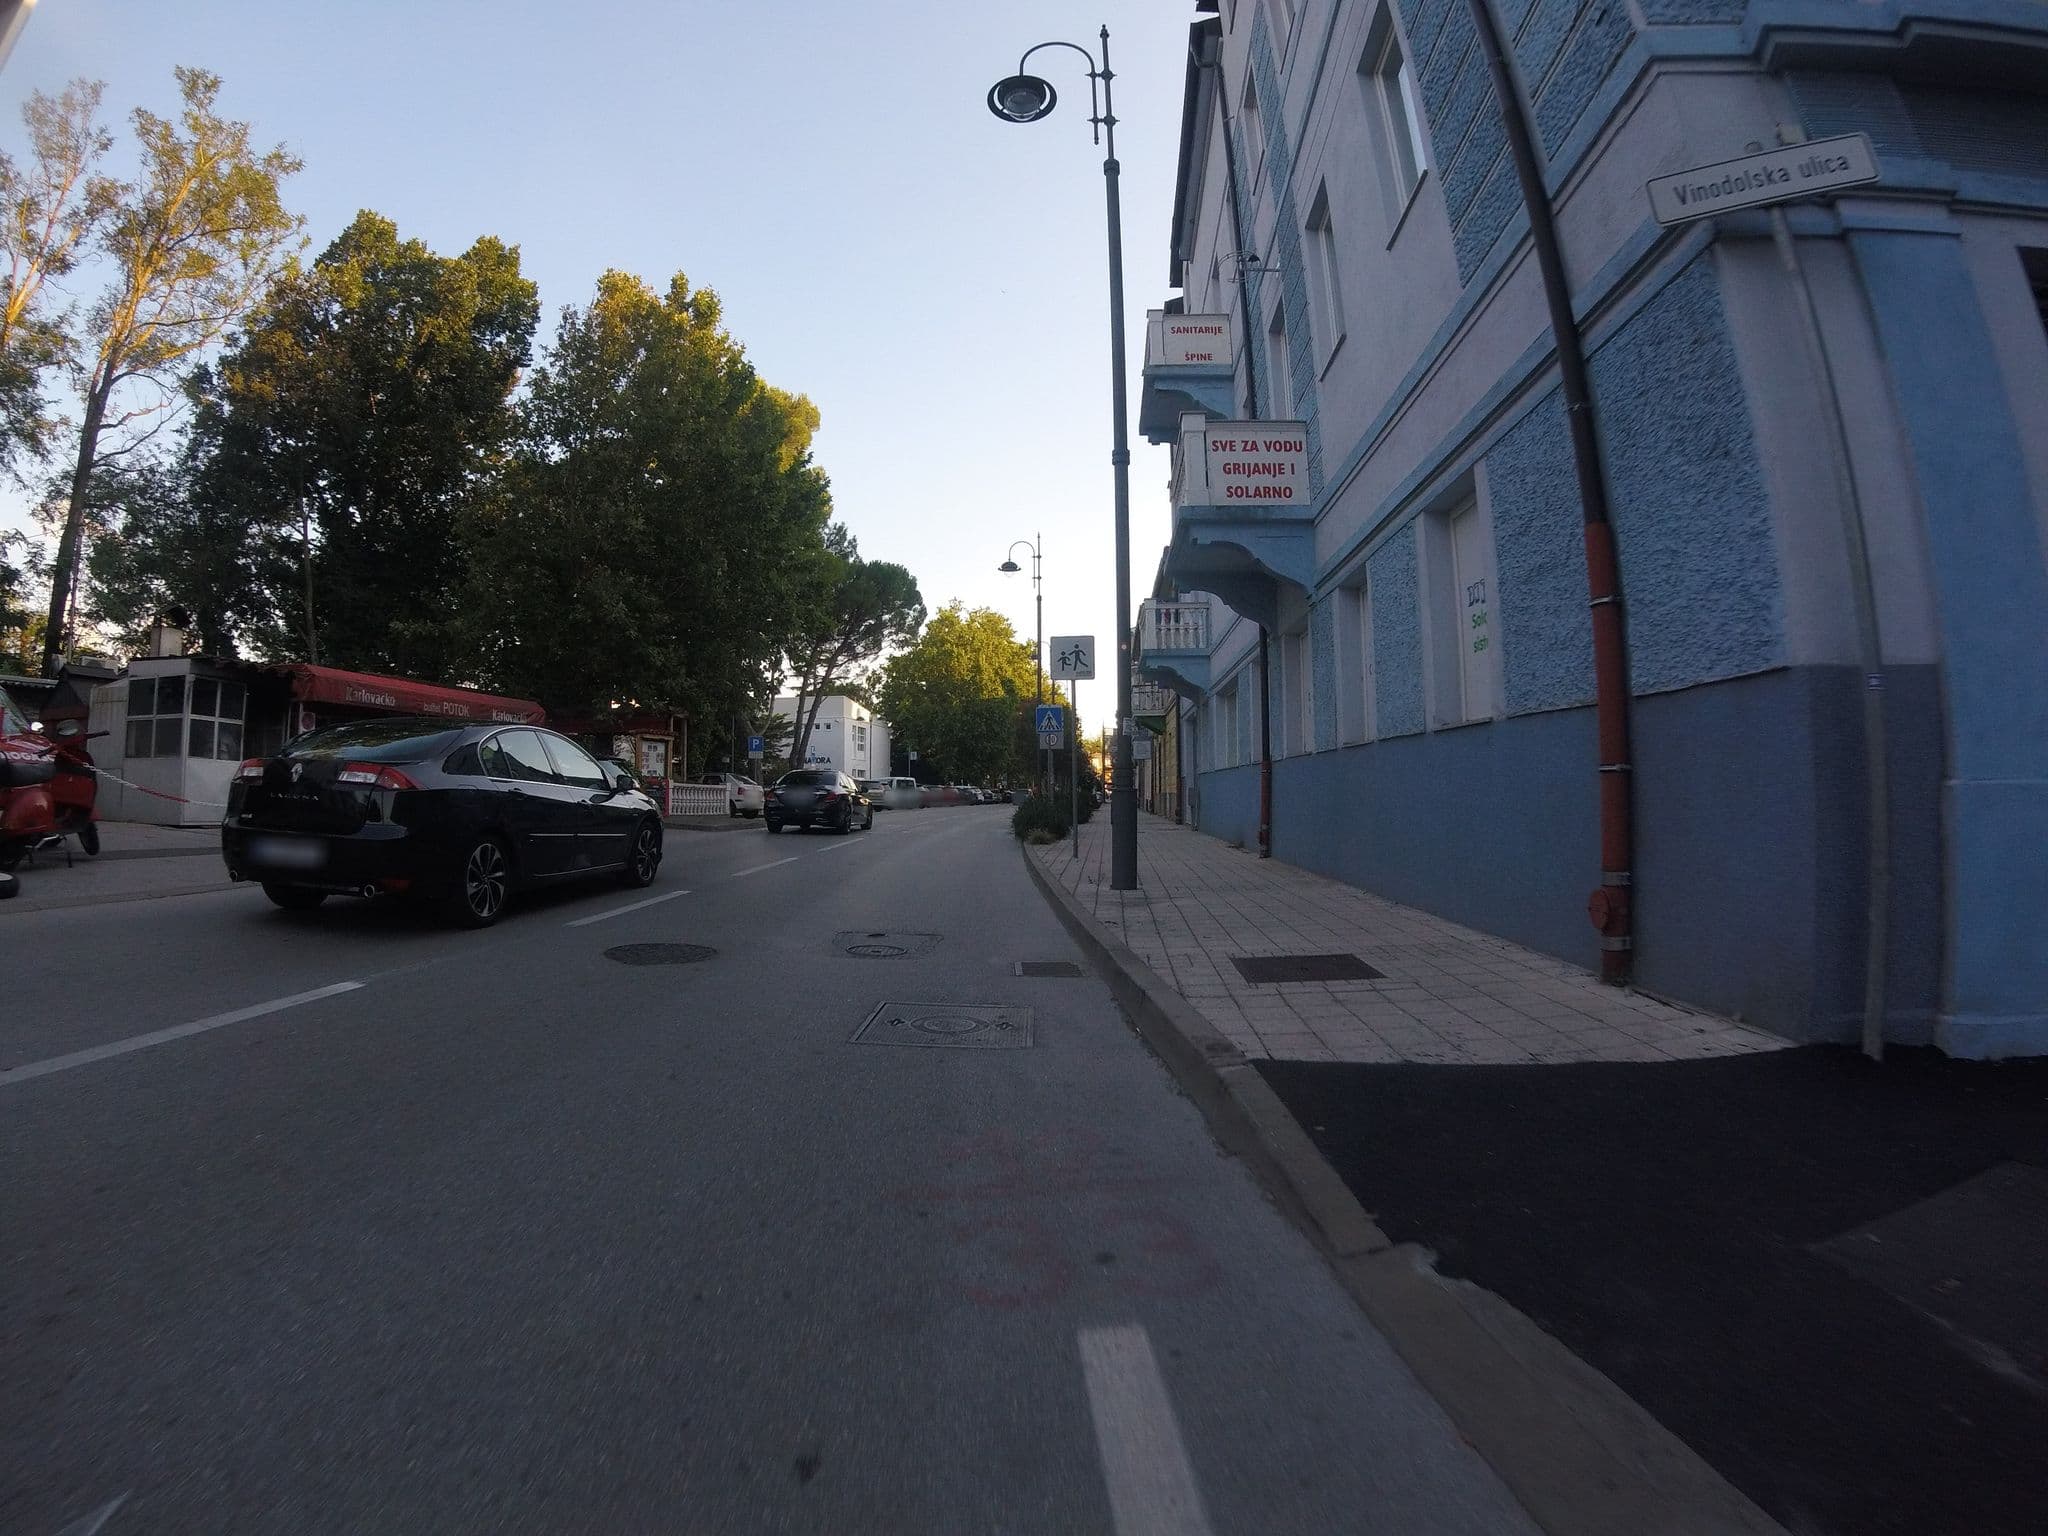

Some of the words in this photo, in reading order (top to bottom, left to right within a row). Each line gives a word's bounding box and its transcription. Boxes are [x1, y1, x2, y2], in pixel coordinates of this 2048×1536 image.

[1674, 166, 1792, 205] Vinodolska
[1797, 155, 1850, 179] ulica
[1170, 326, 1223, 336] SANITARIJE
[1184, 351, 1213, 361] ŠPINE
[1211, 440, 1236, 452] SVE
[1241, 440, 1259, 452] ZA
[1264, 440, 1303, 452] VODU
[1222, 462, 1285, 478] GRIJANJE
[1290, 463, 1295, 475] I
[1226, 485, 1293, 499] SOLARNO
[443, 702, 471, 718] POTOK
[752, 739, 760, 749] P
